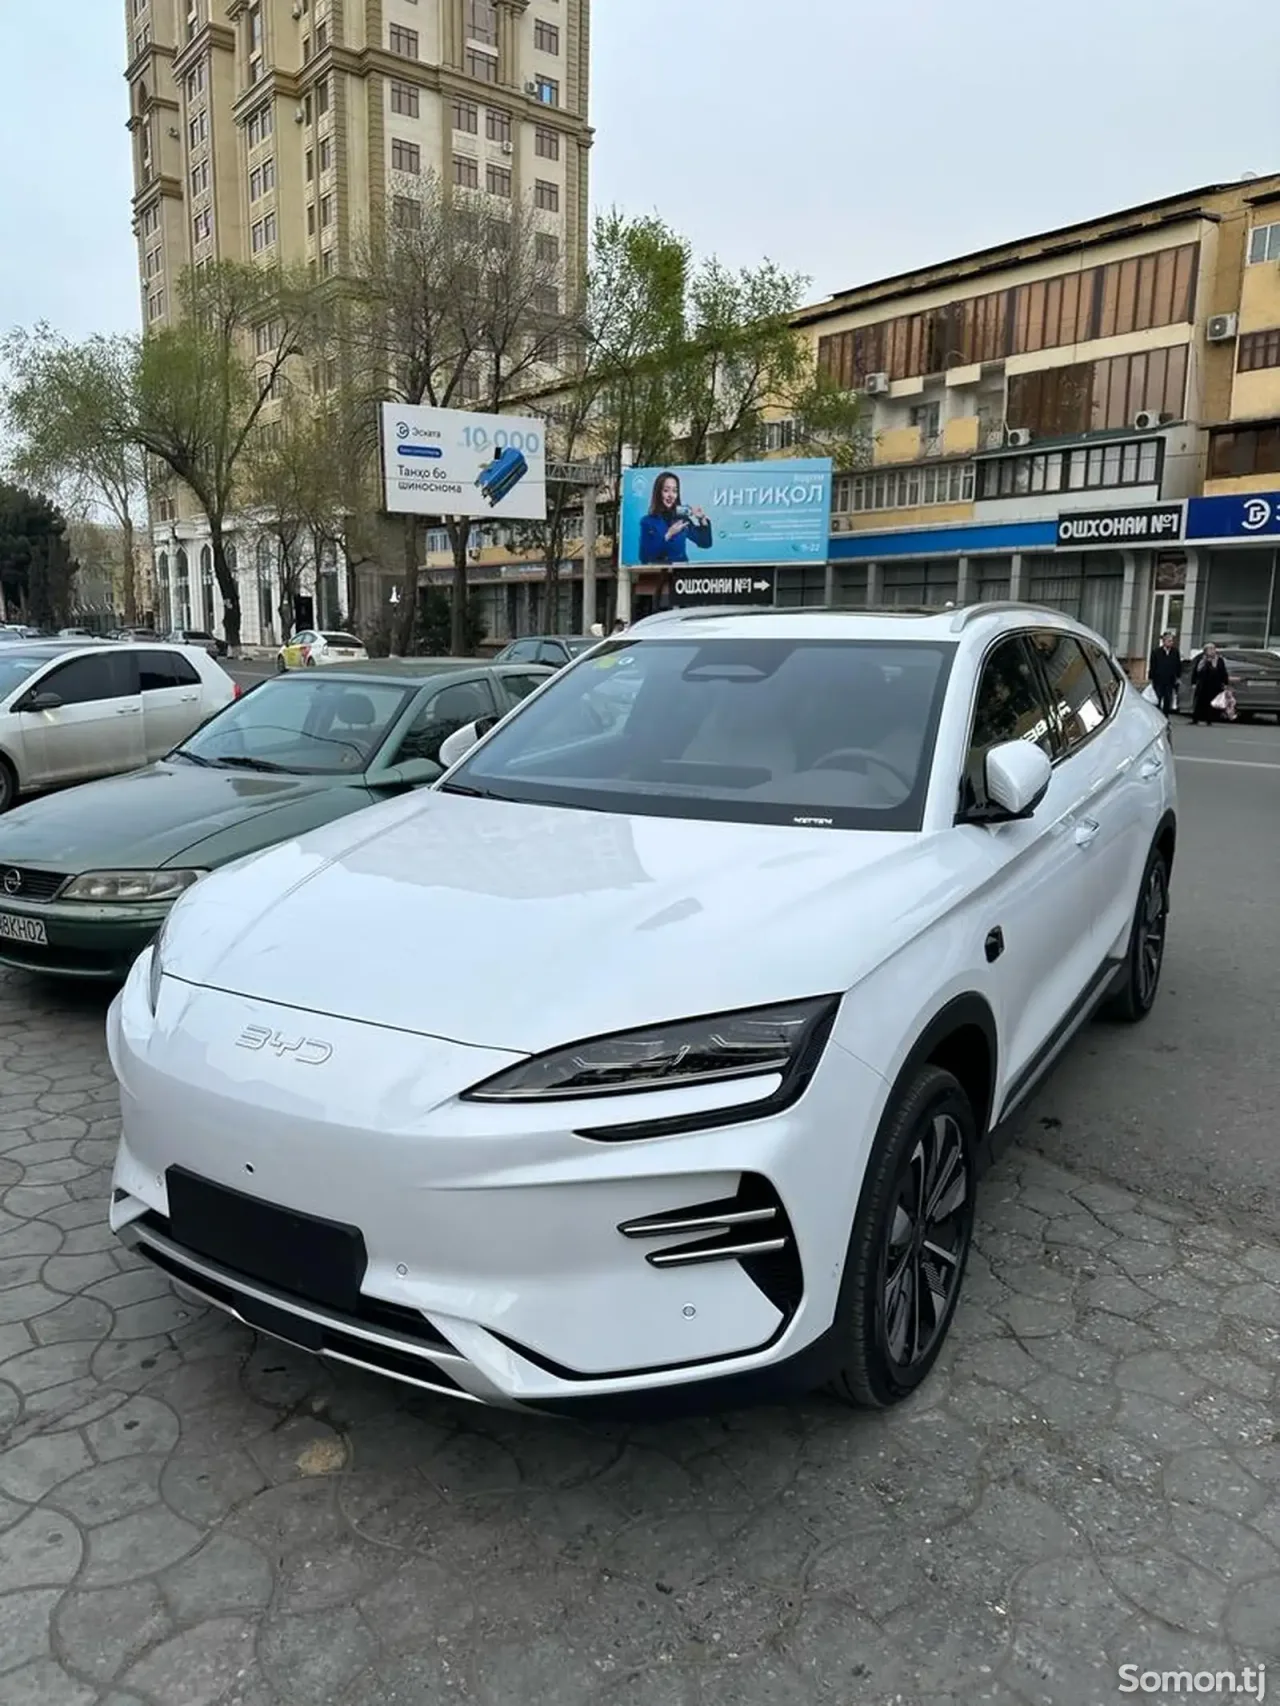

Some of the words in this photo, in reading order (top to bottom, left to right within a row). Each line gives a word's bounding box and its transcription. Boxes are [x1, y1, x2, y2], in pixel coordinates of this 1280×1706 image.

[432, 466, 447, 479] бо
[398, 481, 462, 493] шиноснома
[714, 484, 823, 508] ИНТИҚОЛ
[1059, 514, 1147, 539] ОШХОНАИ
[1150, 513, 1179, 534] №1
[235, 1023, 333, 1065] BYD
